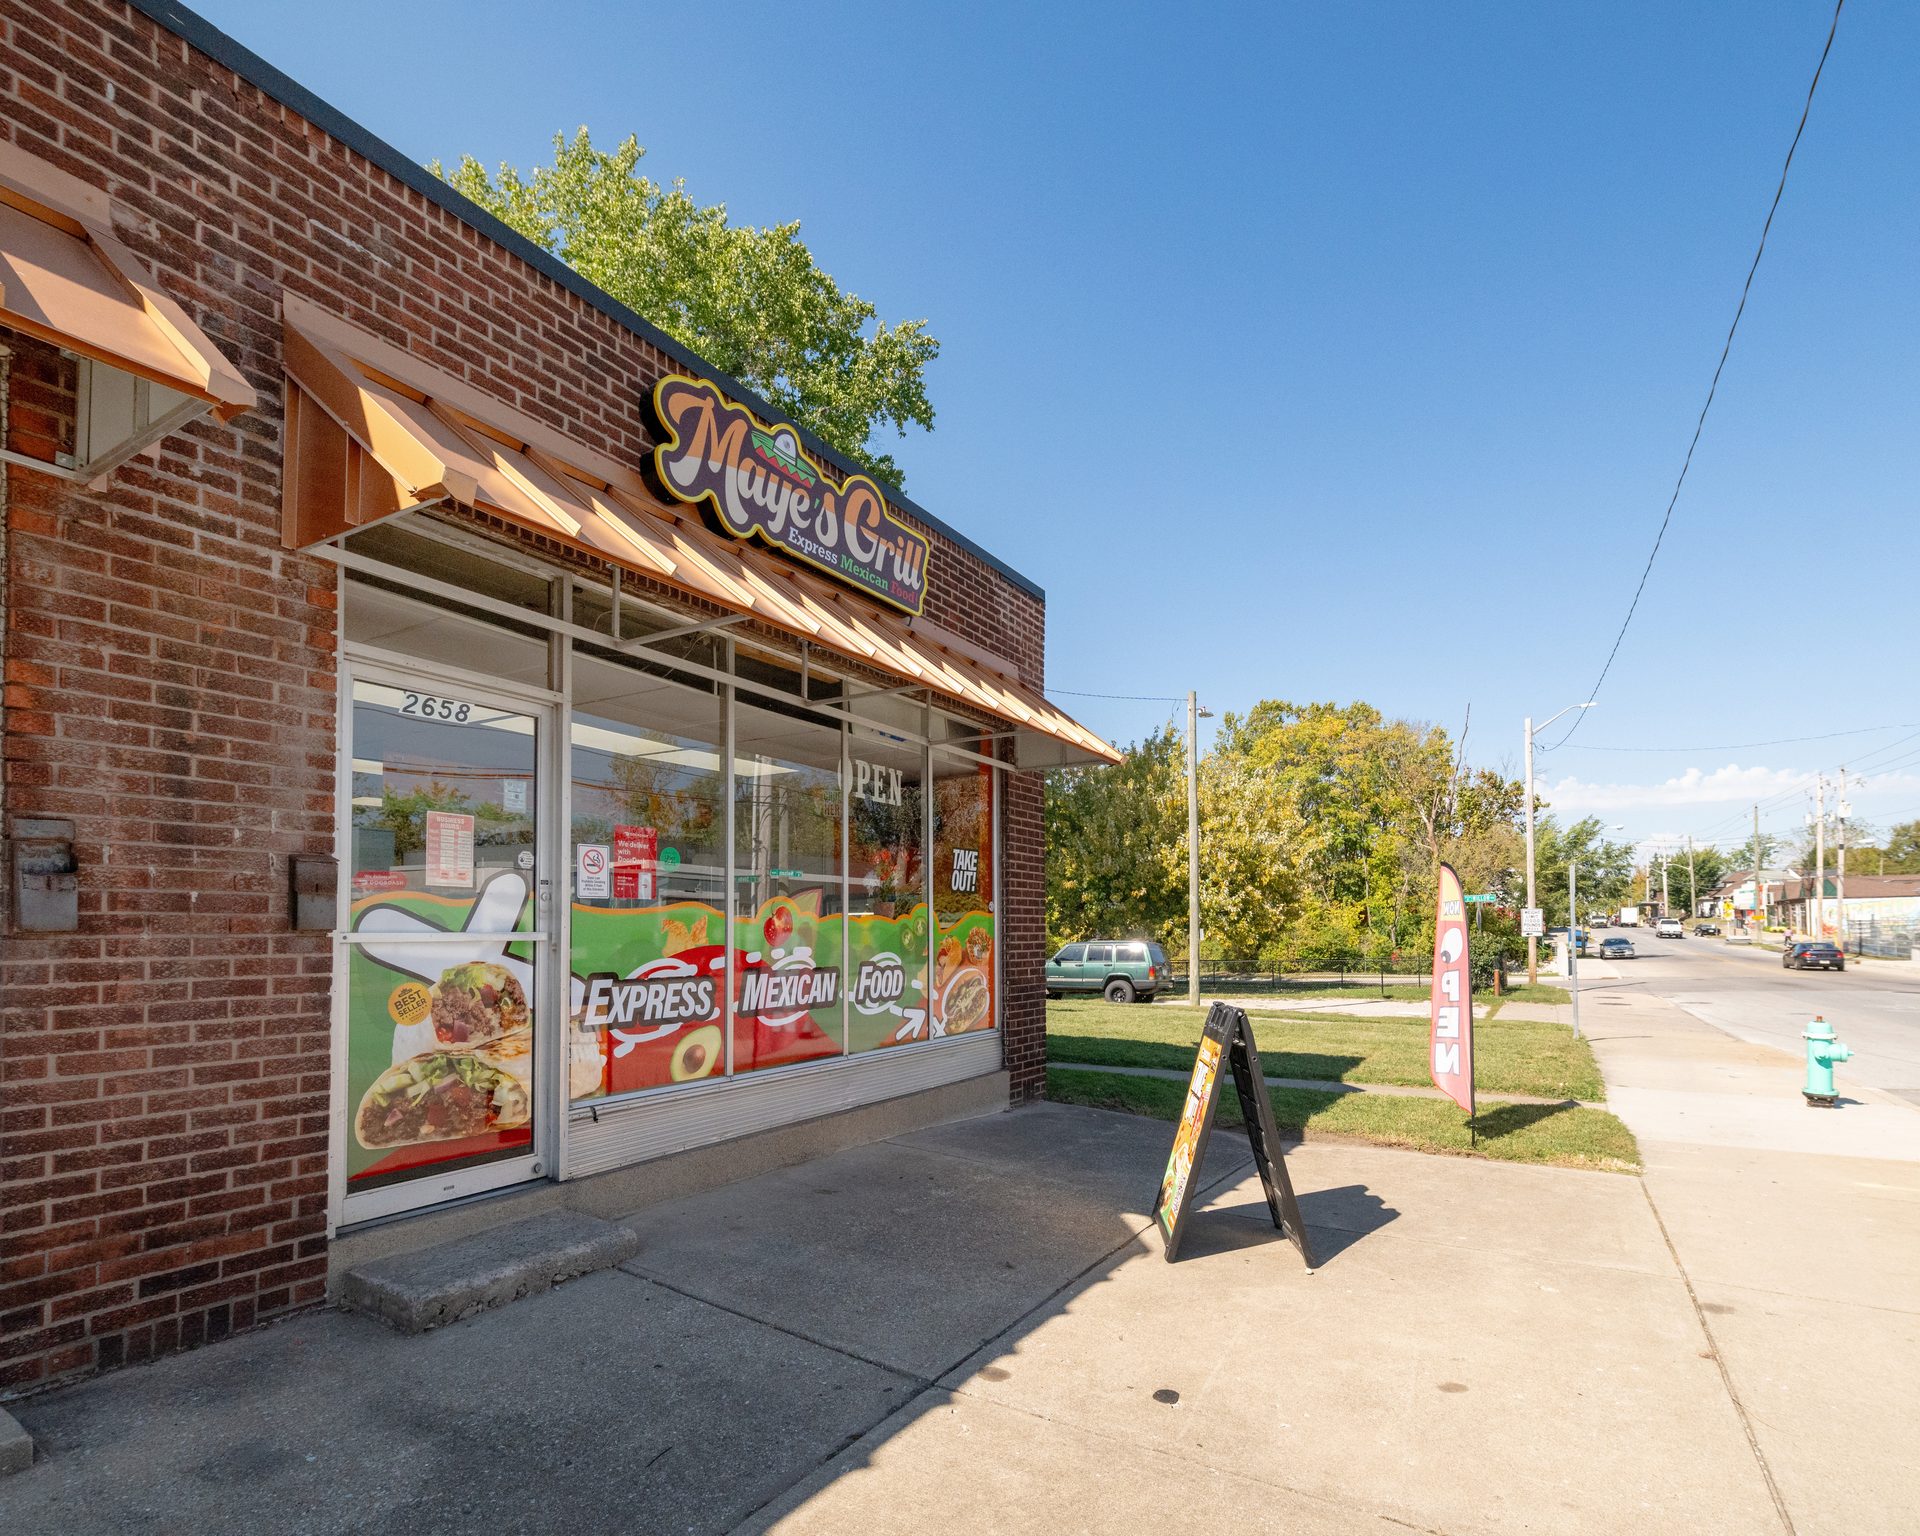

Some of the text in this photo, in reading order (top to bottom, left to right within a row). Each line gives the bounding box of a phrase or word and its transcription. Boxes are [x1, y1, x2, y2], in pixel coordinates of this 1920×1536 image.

[667, 391, 922, 591] Maye's Grill
[788, 526, 917, 604] Express Mexican Food
[402, 694, 471, 722] 2658
[617, 840, 649, 850] We deliver
[617, 856, 647, 865] DoorDash
[953, 849, 979, 871] TAKE
[951, 868, 978, 892] OUT!
[394, 989, 422, 1011] BEST
[584, 965, 904, 1026] EXPRESS MEXICAN FOOD
[397, 997, 428, 1018] SELLER
